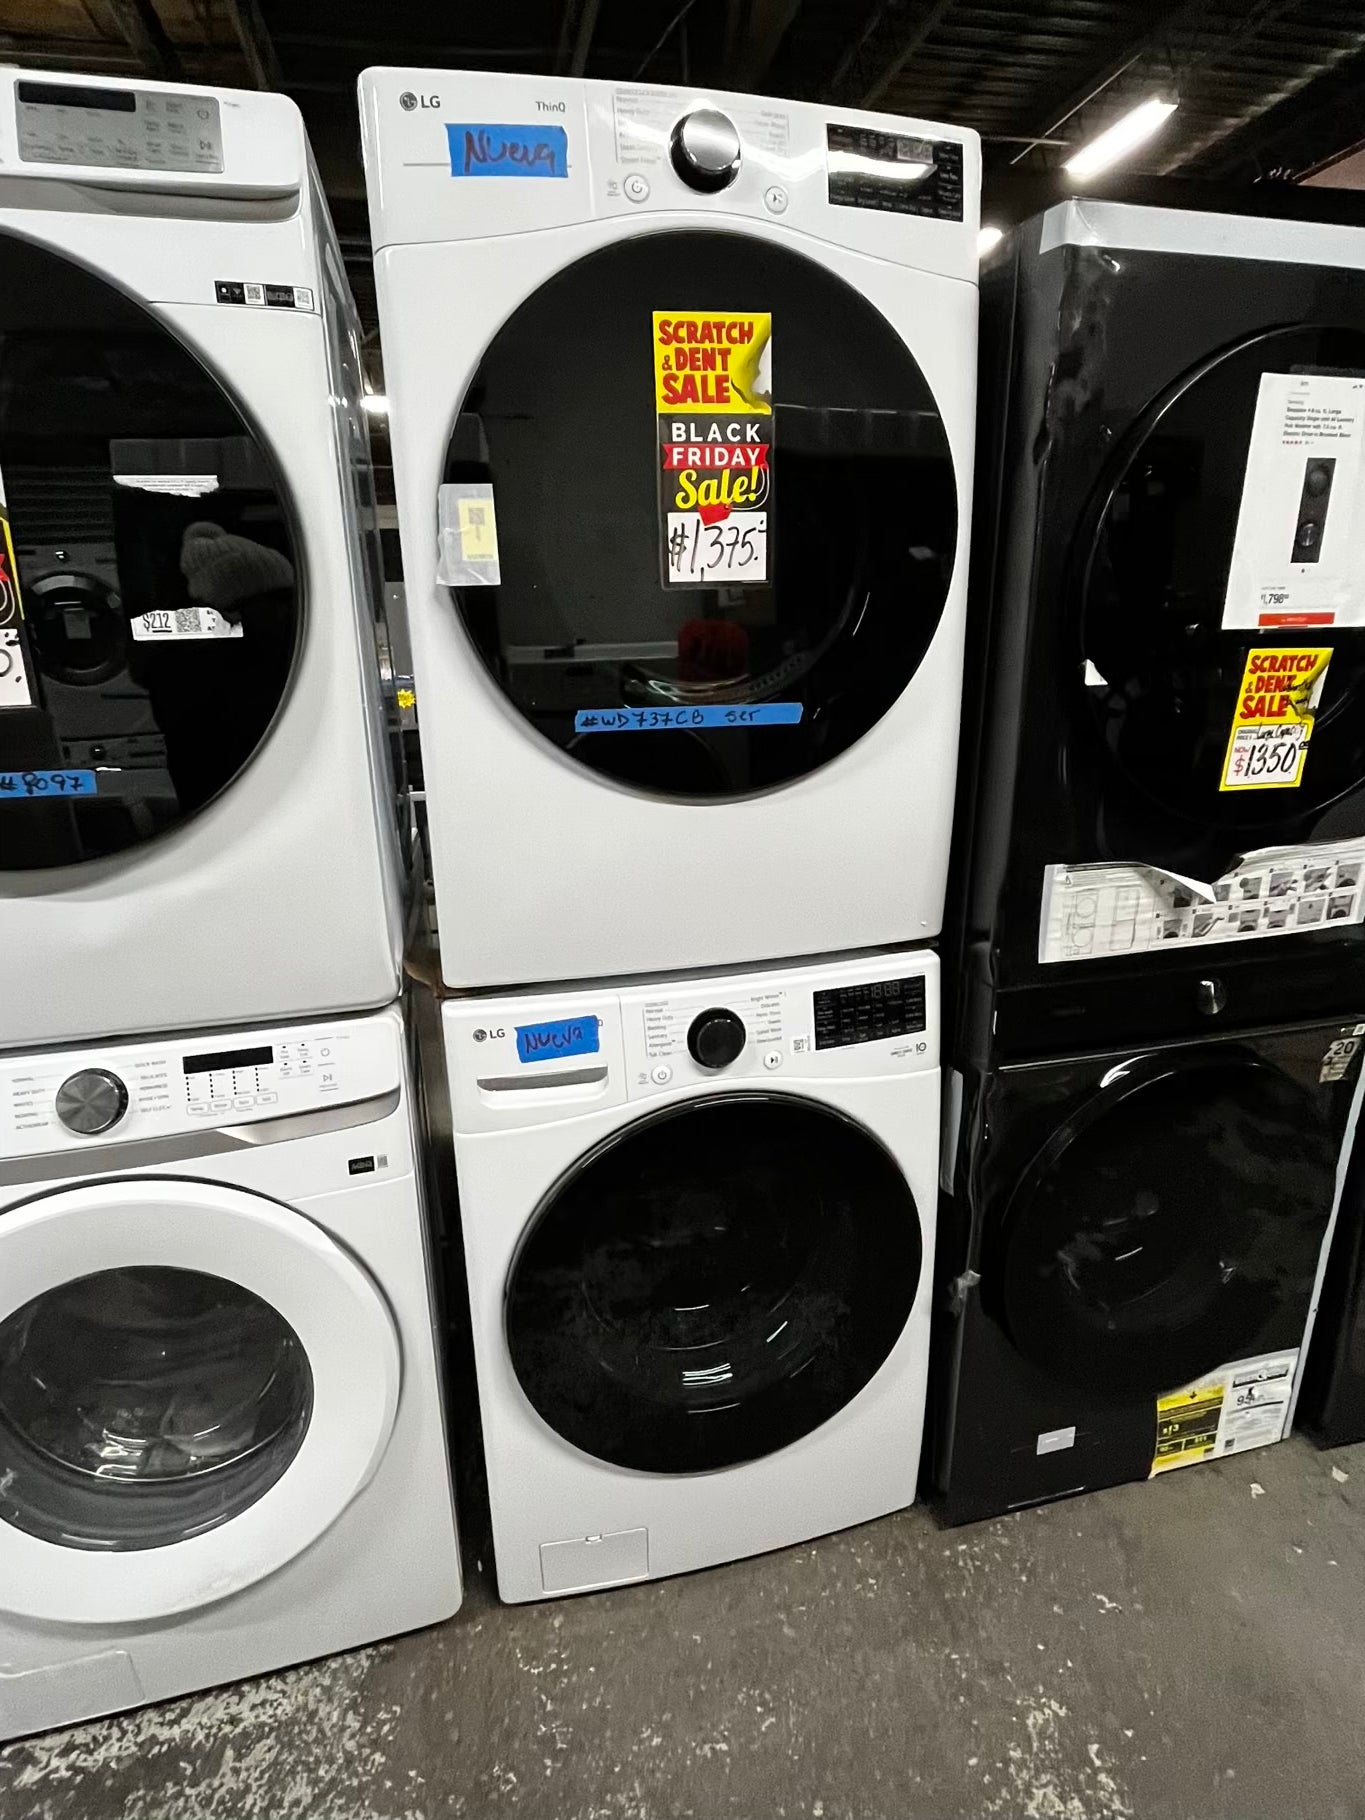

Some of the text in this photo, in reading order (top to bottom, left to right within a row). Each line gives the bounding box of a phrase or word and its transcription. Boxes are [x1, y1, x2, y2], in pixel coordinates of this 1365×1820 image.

[420, 95, 441, 109] LG
[535, 100, 566, 112] ThinQ
[658, 319, 754, 345] SCRATCH
[662, 347, 732, 372] & DENT
[661, 372, 732, 405] SALE
[671, 422, 761, 443] BLACK
[672, 447, 761, 467] FRIDAY
[674, 465, 760, 509] Sale!
[1248, 654, 1318, 674] SCRATCH
[1245, 681, 1253, 694] &
[1240, 694, 1290, 720] SALE
[489, 1029, 506, 1039] LG
[1333, 1041, 1355, 1055] 20
